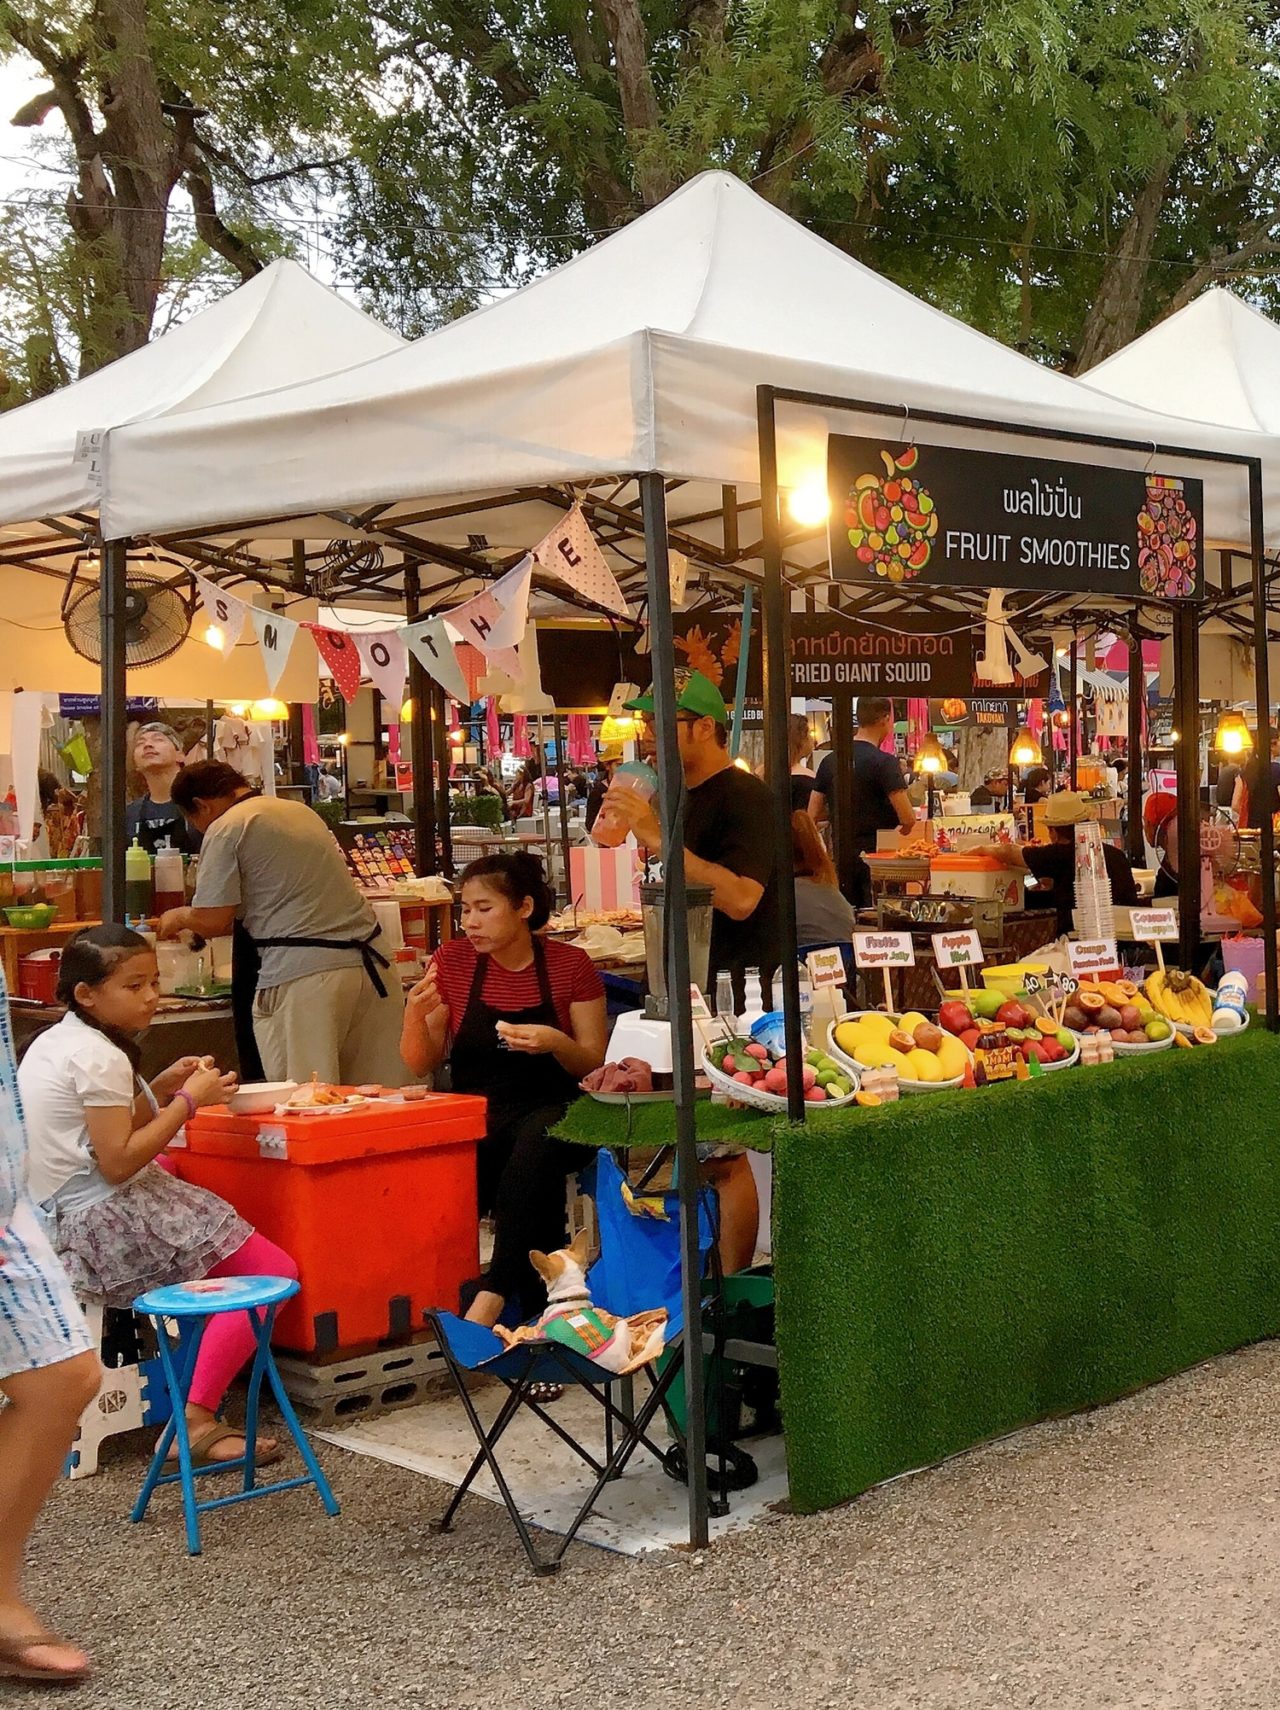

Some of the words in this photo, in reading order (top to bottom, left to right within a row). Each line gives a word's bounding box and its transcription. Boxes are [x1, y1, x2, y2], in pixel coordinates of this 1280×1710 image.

[1003, 477, 1082, 519] ผลไม้ปั่น
[945, 530, 1011, 562] FRUIT
[1019, 536, 1131, 570] SMOOTHIES
[835, 663, 881, 683] GIANT
[885, 662, 931, 682] SQUID
[941, 934, 972, 950] Apple
[1024, 976, 1040, 991] 40
[1061, 977, 1077, 993] 80
